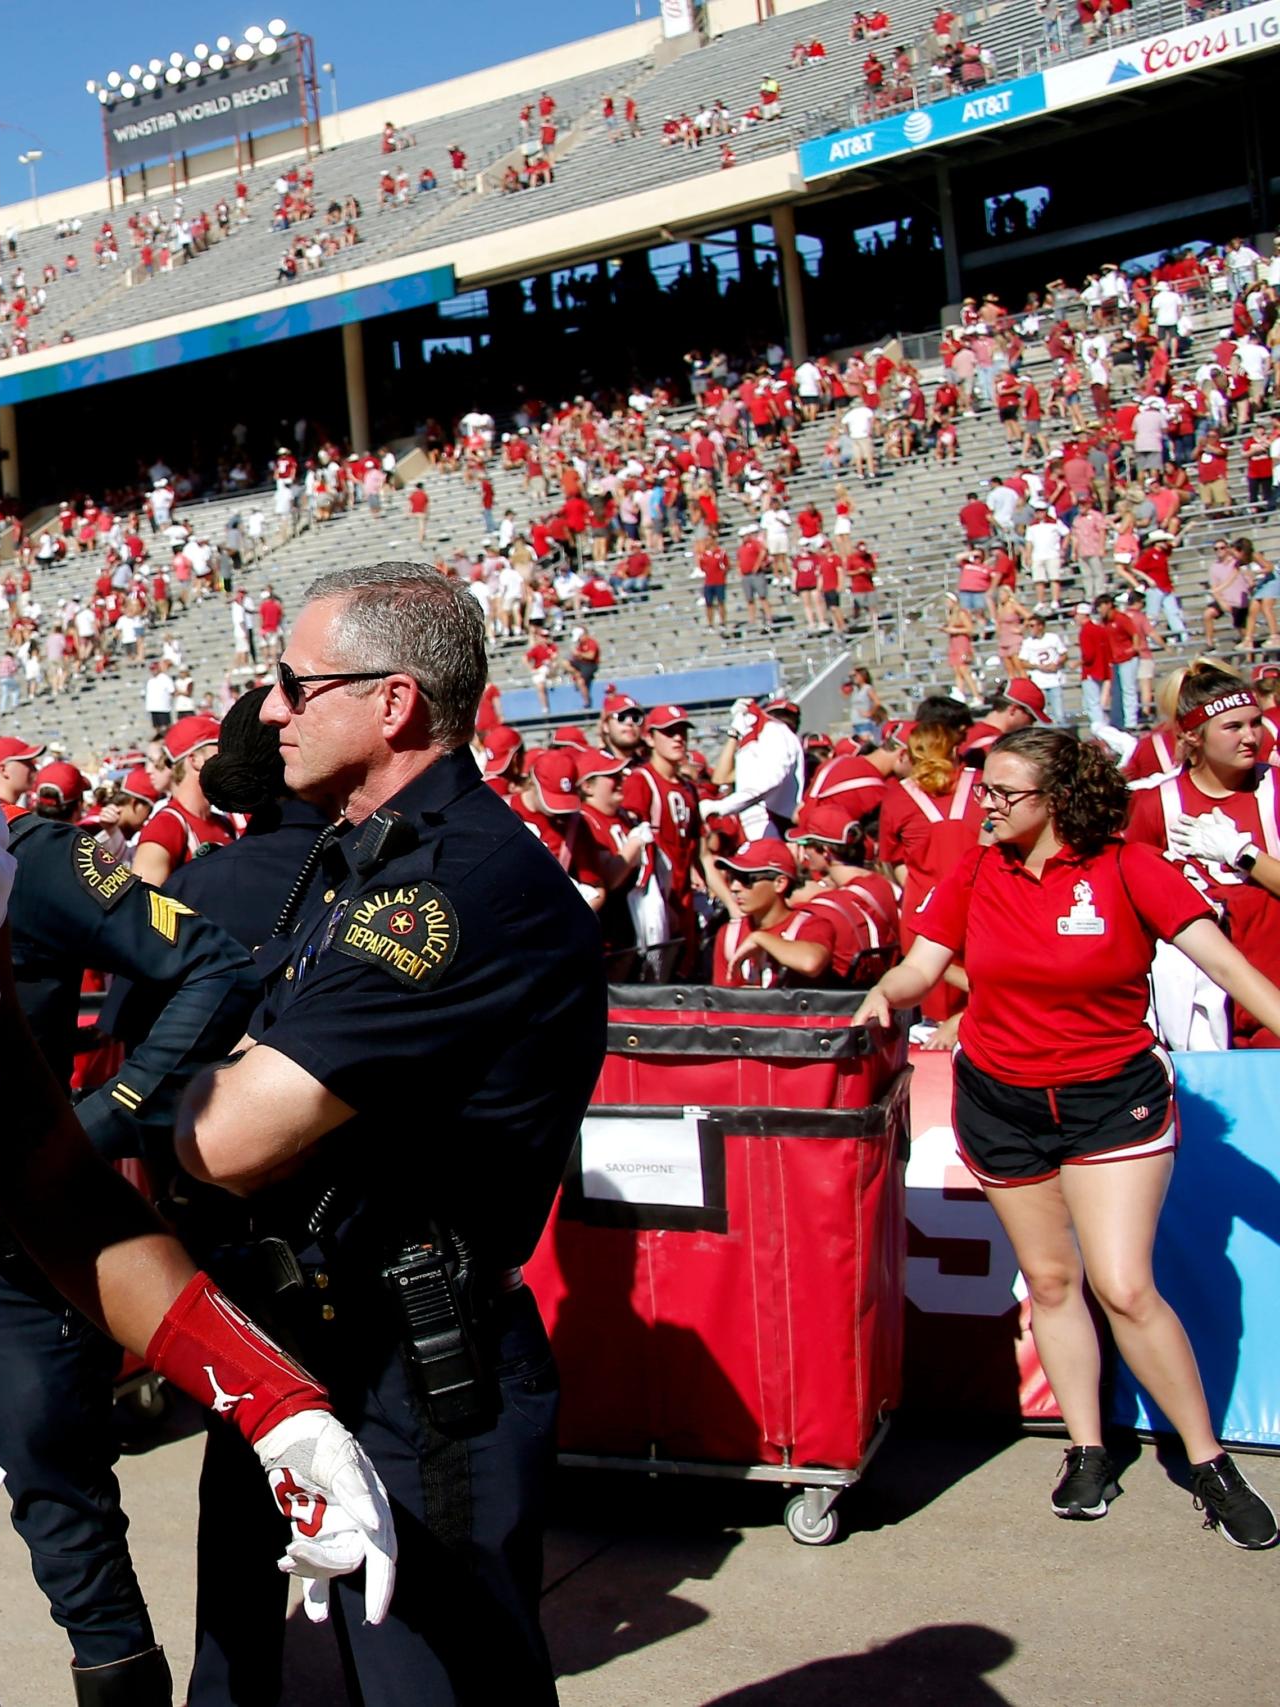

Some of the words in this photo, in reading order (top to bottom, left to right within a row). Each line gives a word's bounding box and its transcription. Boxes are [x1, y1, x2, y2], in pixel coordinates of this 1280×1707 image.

[1141, 31, 1229, 74] Coors
[113, 111, 177, 143] WINSTAR
[176, 98, 231, 123] WORLD
[232, 77, 289, 109] RESORT
[962, 90, 1013, 123] AT&T
[829, 131, 876, 162] AT&T
[1204, 692, 1252, 717] BONES
[77, 837, 101, 887] DALLAS
[353, 887, 419, 924] DALLAS
[418, 898, 450, 963] POLICE
[344, 923, 432, 980] DEPARTMENT
[605, 1162, 675, 1175] SAXOPHONE
